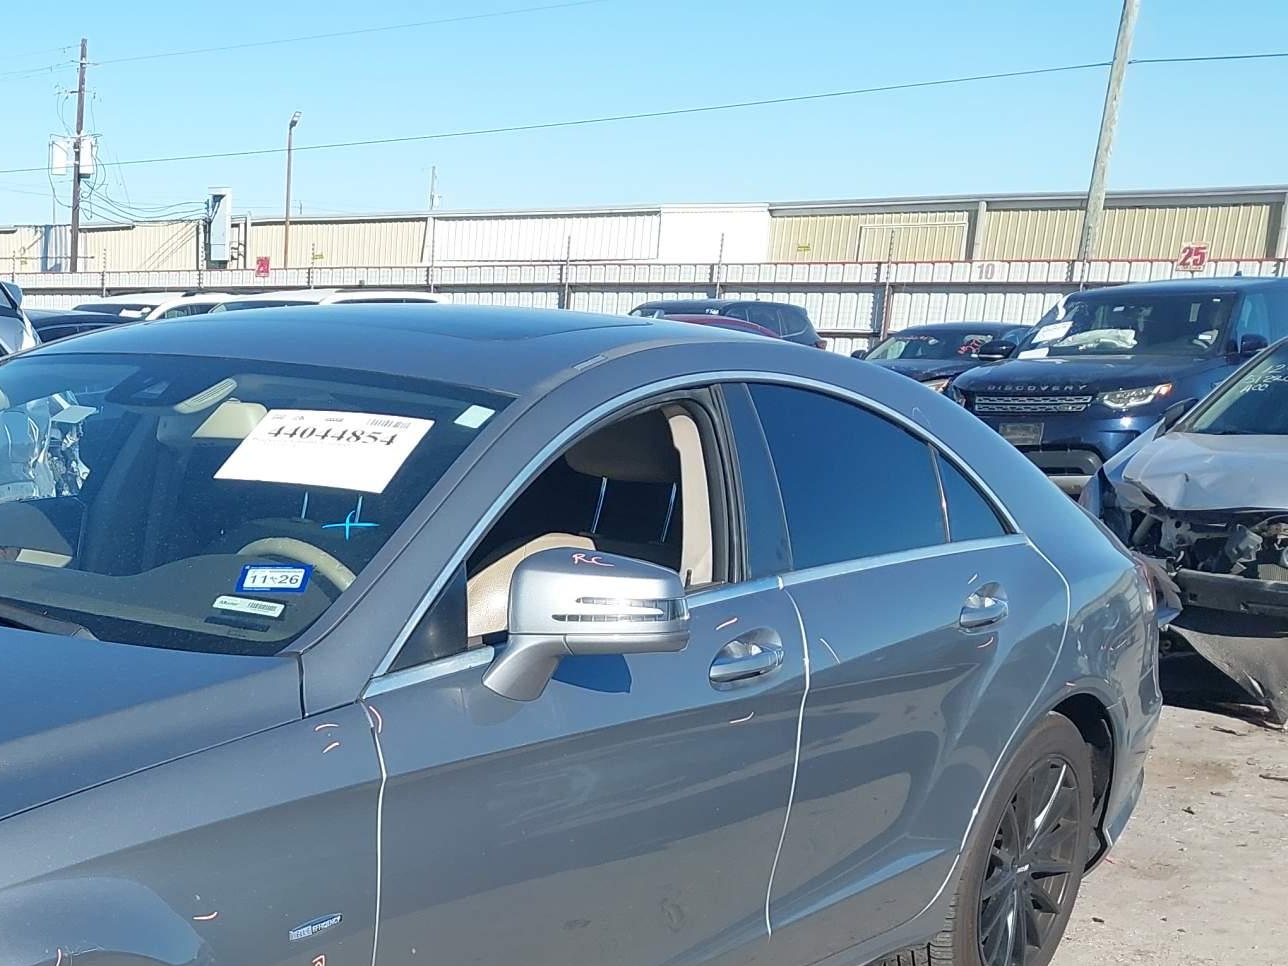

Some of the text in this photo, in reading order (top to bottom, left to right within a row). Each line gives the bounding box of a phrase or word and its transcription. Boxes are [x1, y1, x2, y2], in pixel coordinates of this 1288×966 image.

[1179, 246, 1207, 266] 25
[978, 263, 995, 280] 10
[267, 425, 398, 446] 44044854
[250, 574, 300, 585] 11 26
